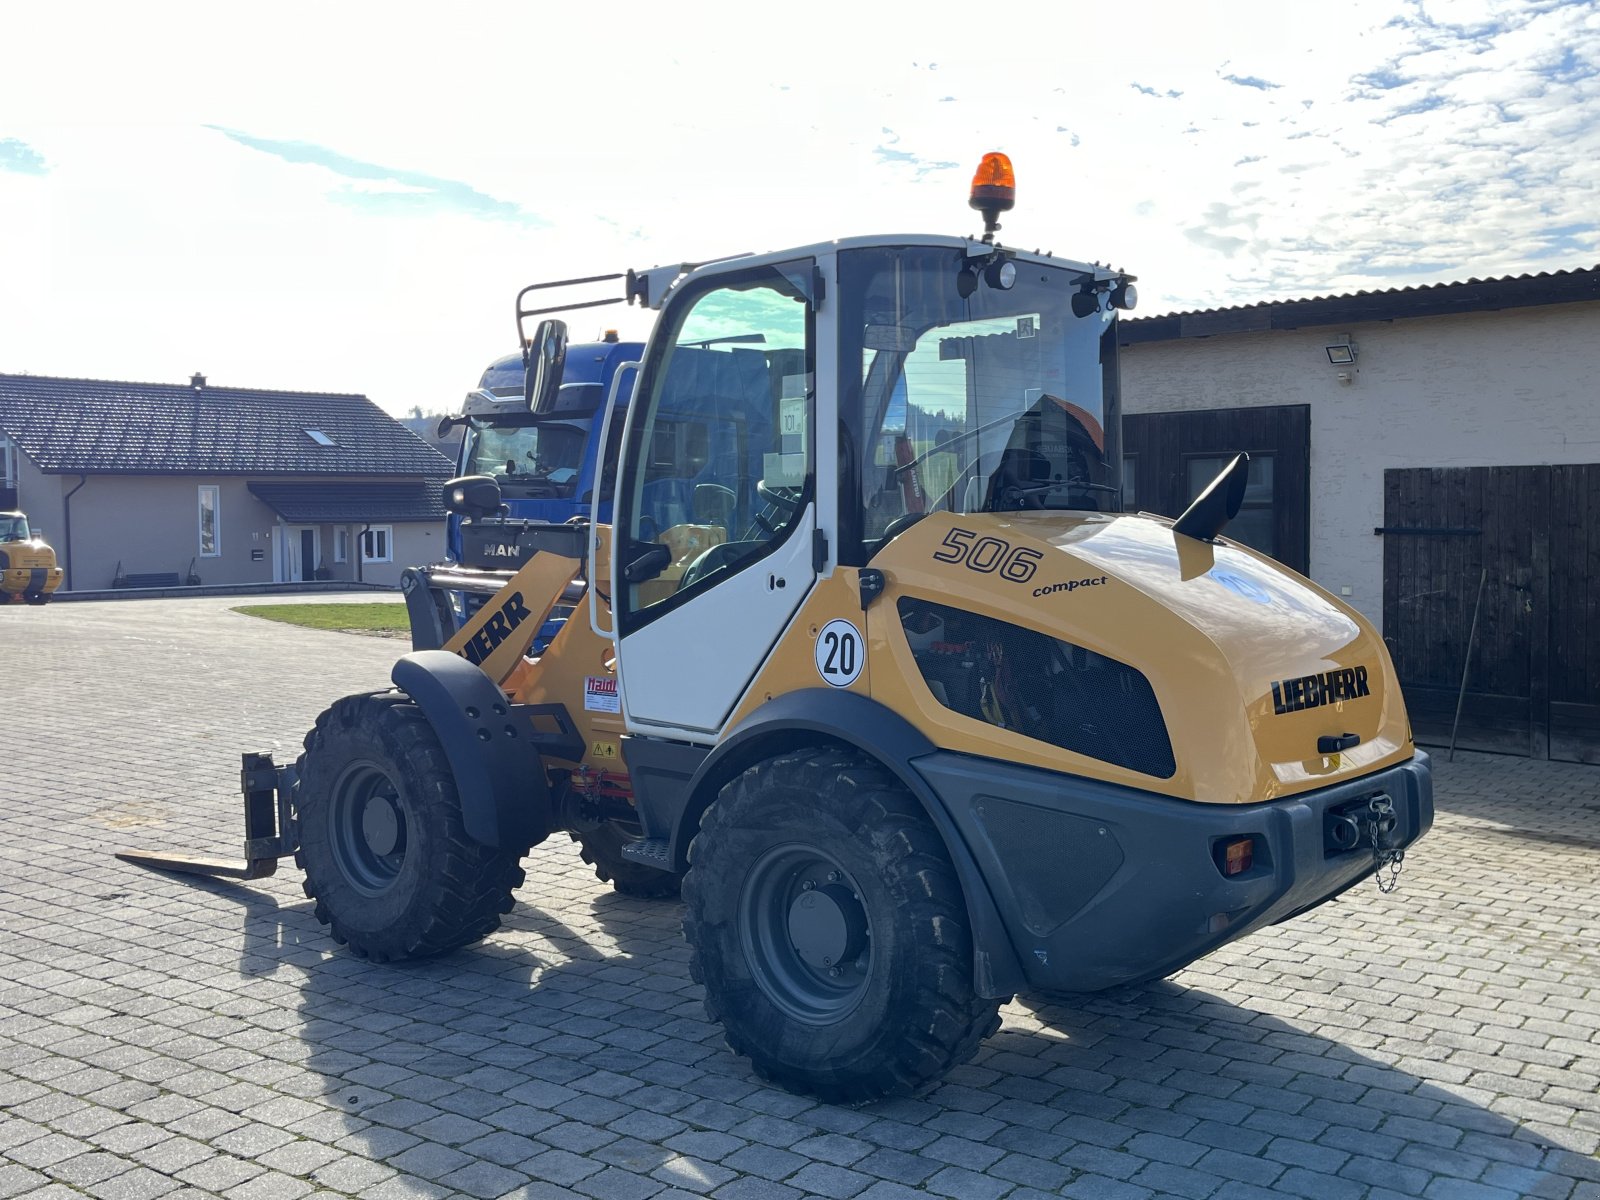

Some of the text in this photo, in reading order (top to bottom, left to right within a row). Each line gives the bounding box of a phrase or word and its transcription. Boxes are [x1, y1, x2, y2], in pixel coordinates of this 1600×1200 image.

[483, 544, 520, 557] MAN
[933, 527, 1044, 583] 506
[1032, 576, 1108, 597] compact
[824, 632, 855, 675] 20
[1270, 666, 1370, 715] LIEBHERR
